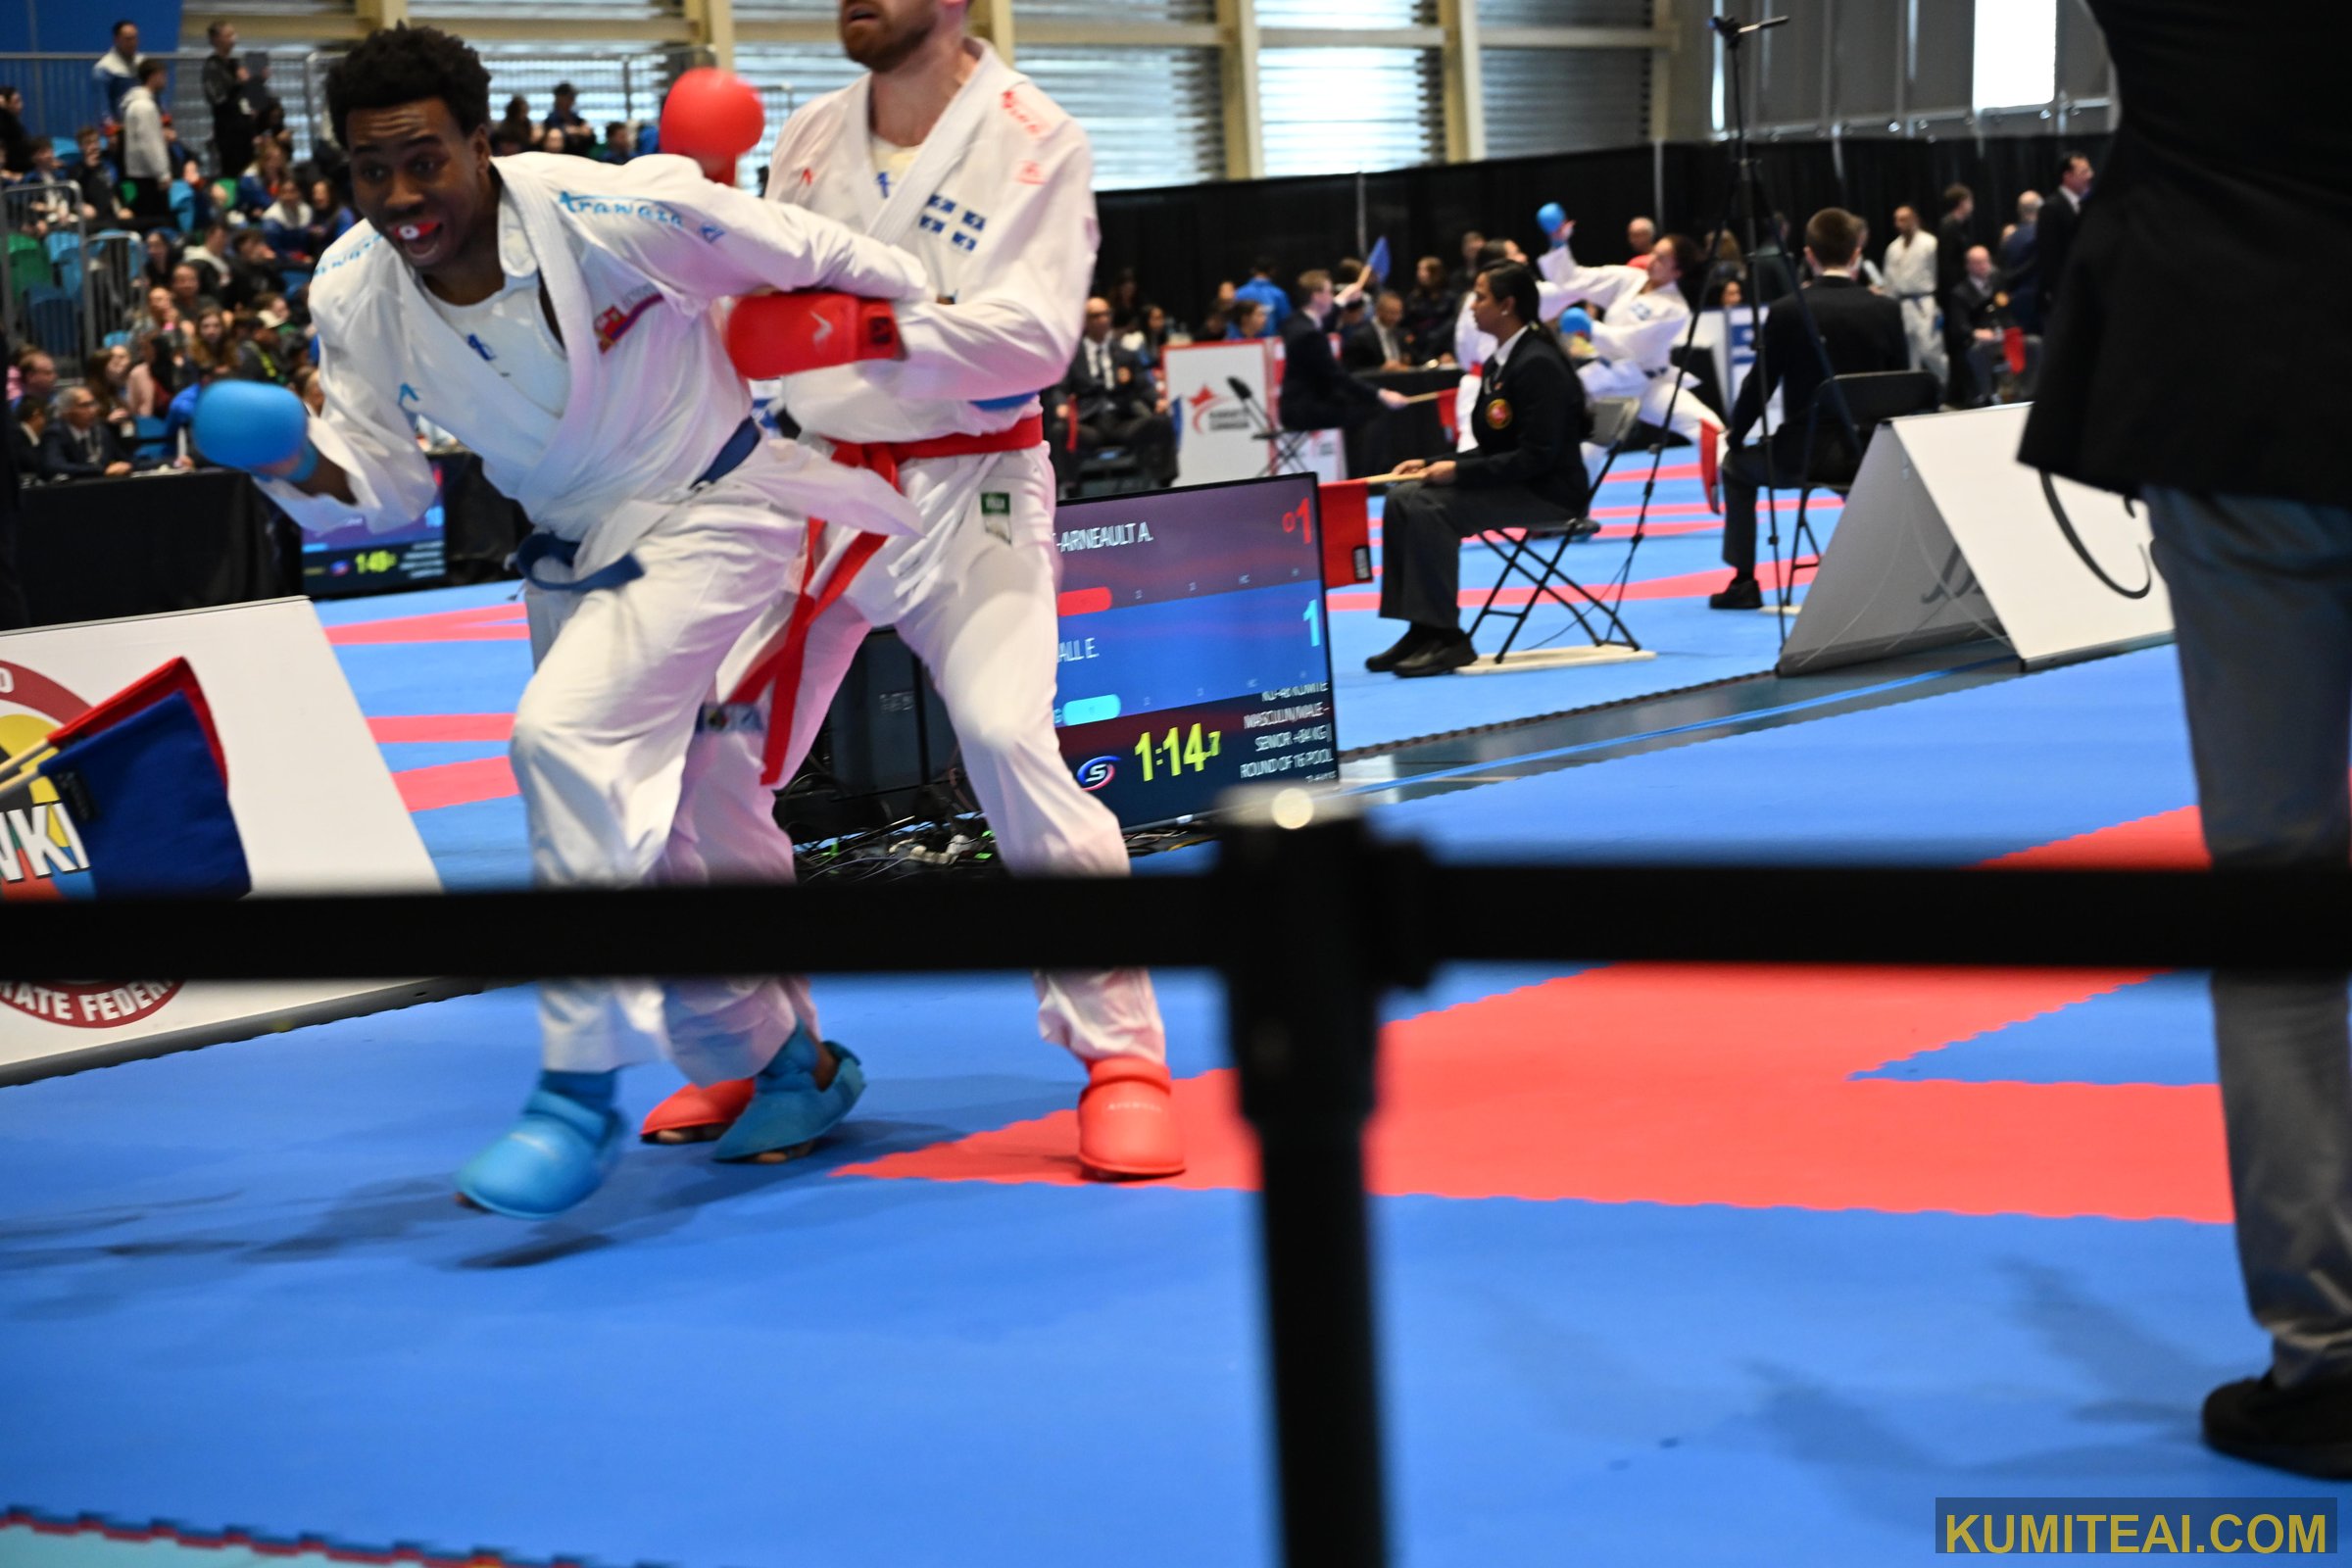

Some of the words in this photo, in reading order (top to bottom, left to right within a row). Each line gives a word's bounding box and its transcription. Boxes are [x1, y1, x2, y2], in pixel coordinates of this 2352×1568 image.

[1053, 522, 1136, 553] -ARNEAULT
[1303, 599, 1320, 647] 1
[1255, 731, 1293, 752] SENIOR
[1240, 759, 1278, 778] ROUND
[1278, 755, 1293, 771] OF
[78, 980, 173, 1021] FEDER
